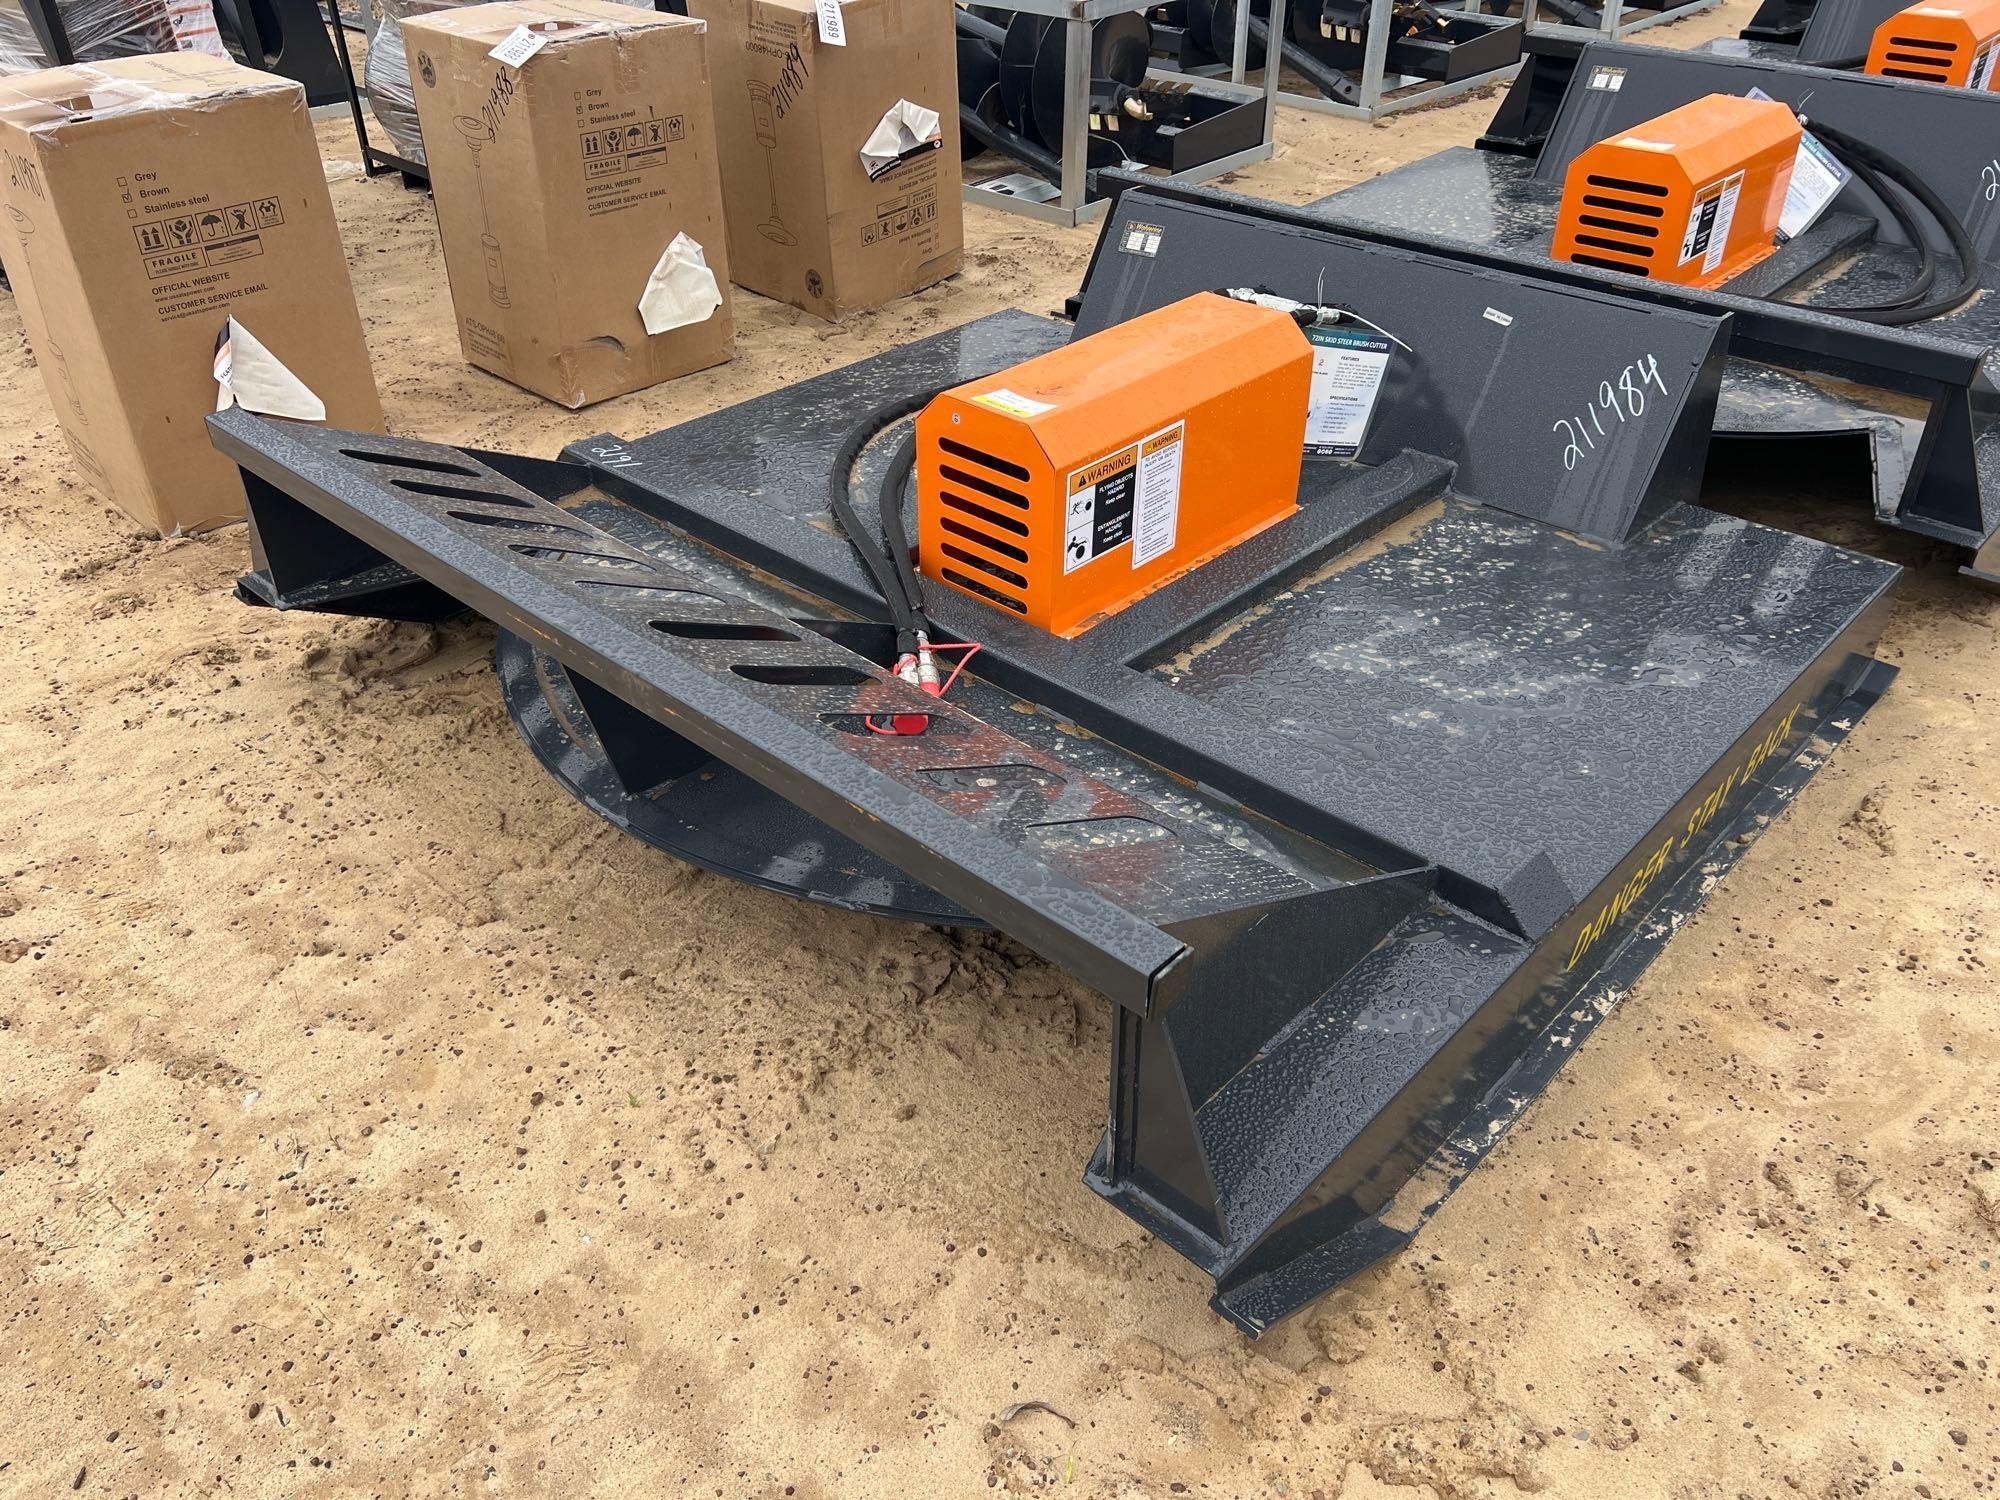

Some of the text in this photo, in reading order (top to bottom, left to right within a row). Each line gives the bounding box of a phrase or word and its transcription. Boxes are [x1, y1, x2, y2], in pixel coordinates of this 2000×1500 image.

[824, 2, 840, 38] 211989
[772, 43, 809, 120] 211989
[586, 89, 602, 97] Grey
[588, 102, 610, 112] Brown
[590, 110, 636, 125] Stainless steel
[590, 159, 622, 171] FRAGILE
[135, 171, 158, 183] Grey
[586, 177, 642, 194] OFFICIAL WEBSITE
[1982, 160, 2000, 201] 2
[139, 186, 170, 199] Brown
[588, 199, 622, 211] CUSTOMER
[623, 193, 649, 204] SERVICE
[649, 189, 667, 199] EMAIL
[144, 194, 211, 215] Stainless steel
[152, 252, 198, 269] FRAGILE
[152, 272, 231, 296] OFFICIAL WEBSITE
[158, 283, 269, 315] CUSTOMER SERVICE EMAIL
[1337, 338, 1353, 346] STEER
[1353, 340, 1370, 348] BRUSH
[1369, 342, 1388, 350] CUTTER
[1553, 354, 1668, 471] 211984
[1152, 431, 1179, 450] WARNING
[1087, 454, 1132, 483] WARNING
[1099, 472, 1134, 494] FLYING OBJECTS
[1107, 483, 1125, 496] HAZARD
[1105, 492, 1126, 506] Keep clear
[1097, 511, 1132, 532] ENTANGLEMENT
[1105, 522, 1123, 535] HAZARD
[1566, 703, 1801, 972] DANGER STAY BACK
